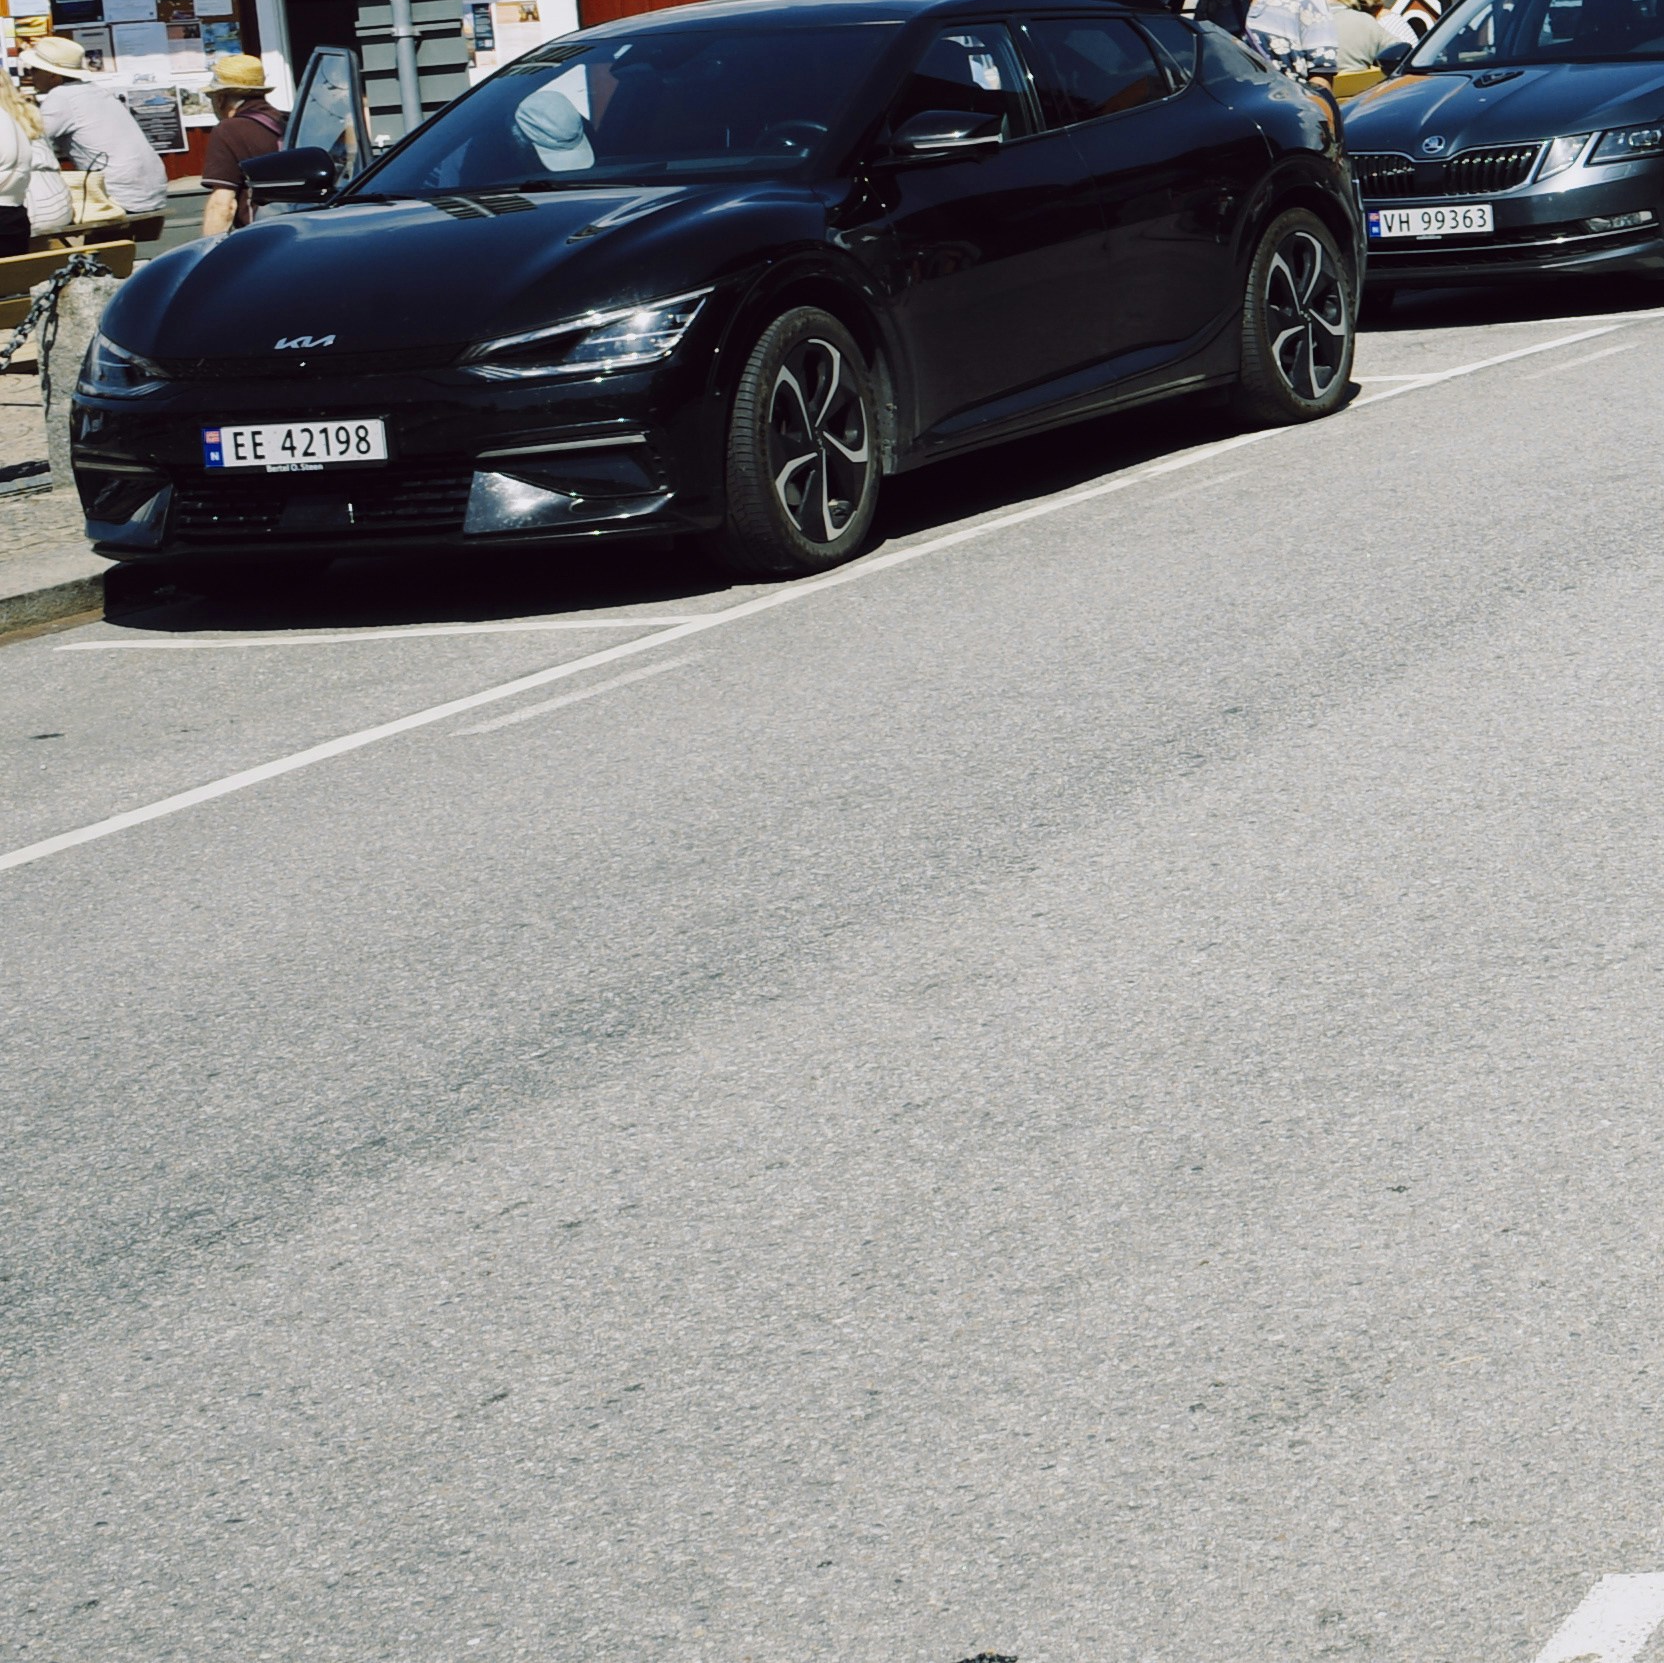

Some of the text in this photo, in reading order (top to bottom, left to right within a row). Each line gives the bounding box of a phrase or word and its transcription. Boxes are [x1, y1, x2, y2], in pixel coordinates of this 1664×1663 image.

[1384, 208, 1487, 233] VH 99363
[233, 425, 372, 461] EE 42198
